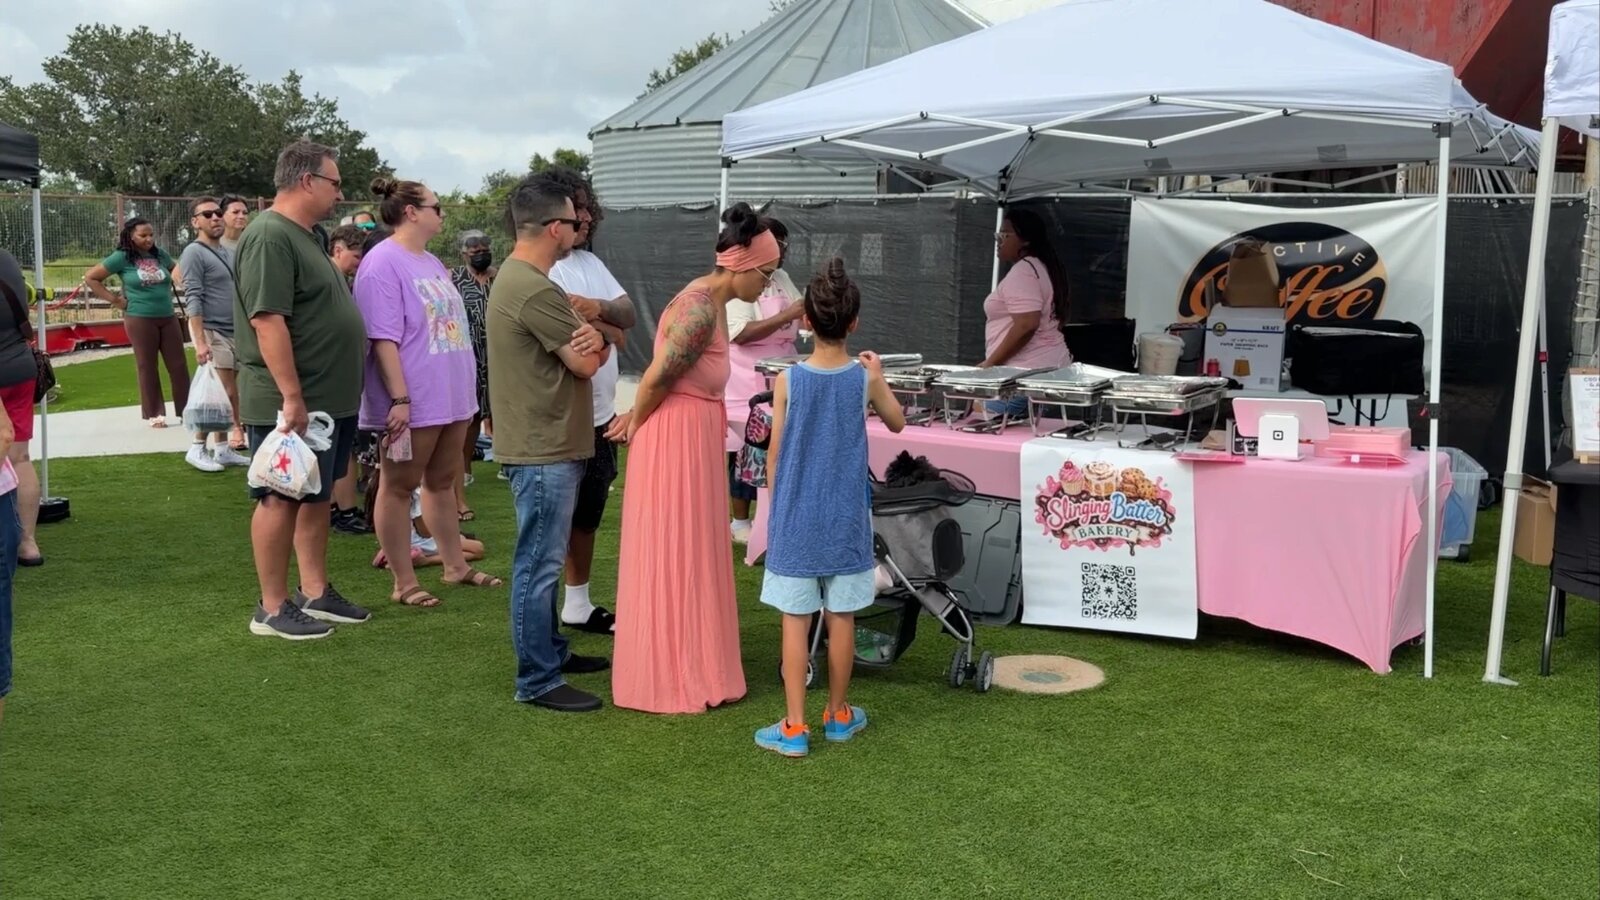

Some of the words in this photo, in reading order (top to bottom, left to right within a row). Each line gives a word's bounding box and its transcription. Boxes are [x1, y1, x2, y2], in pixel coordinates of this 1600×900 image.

[1273, 242, 1366, 267] CTIVE
[1190, 263, 1373, 322] Cffee
[1047, 497, 1112, 528] Slinging
[1112, 493, 1164, 524] Batter
[1079, 525, 1133, 539] BAKERY
